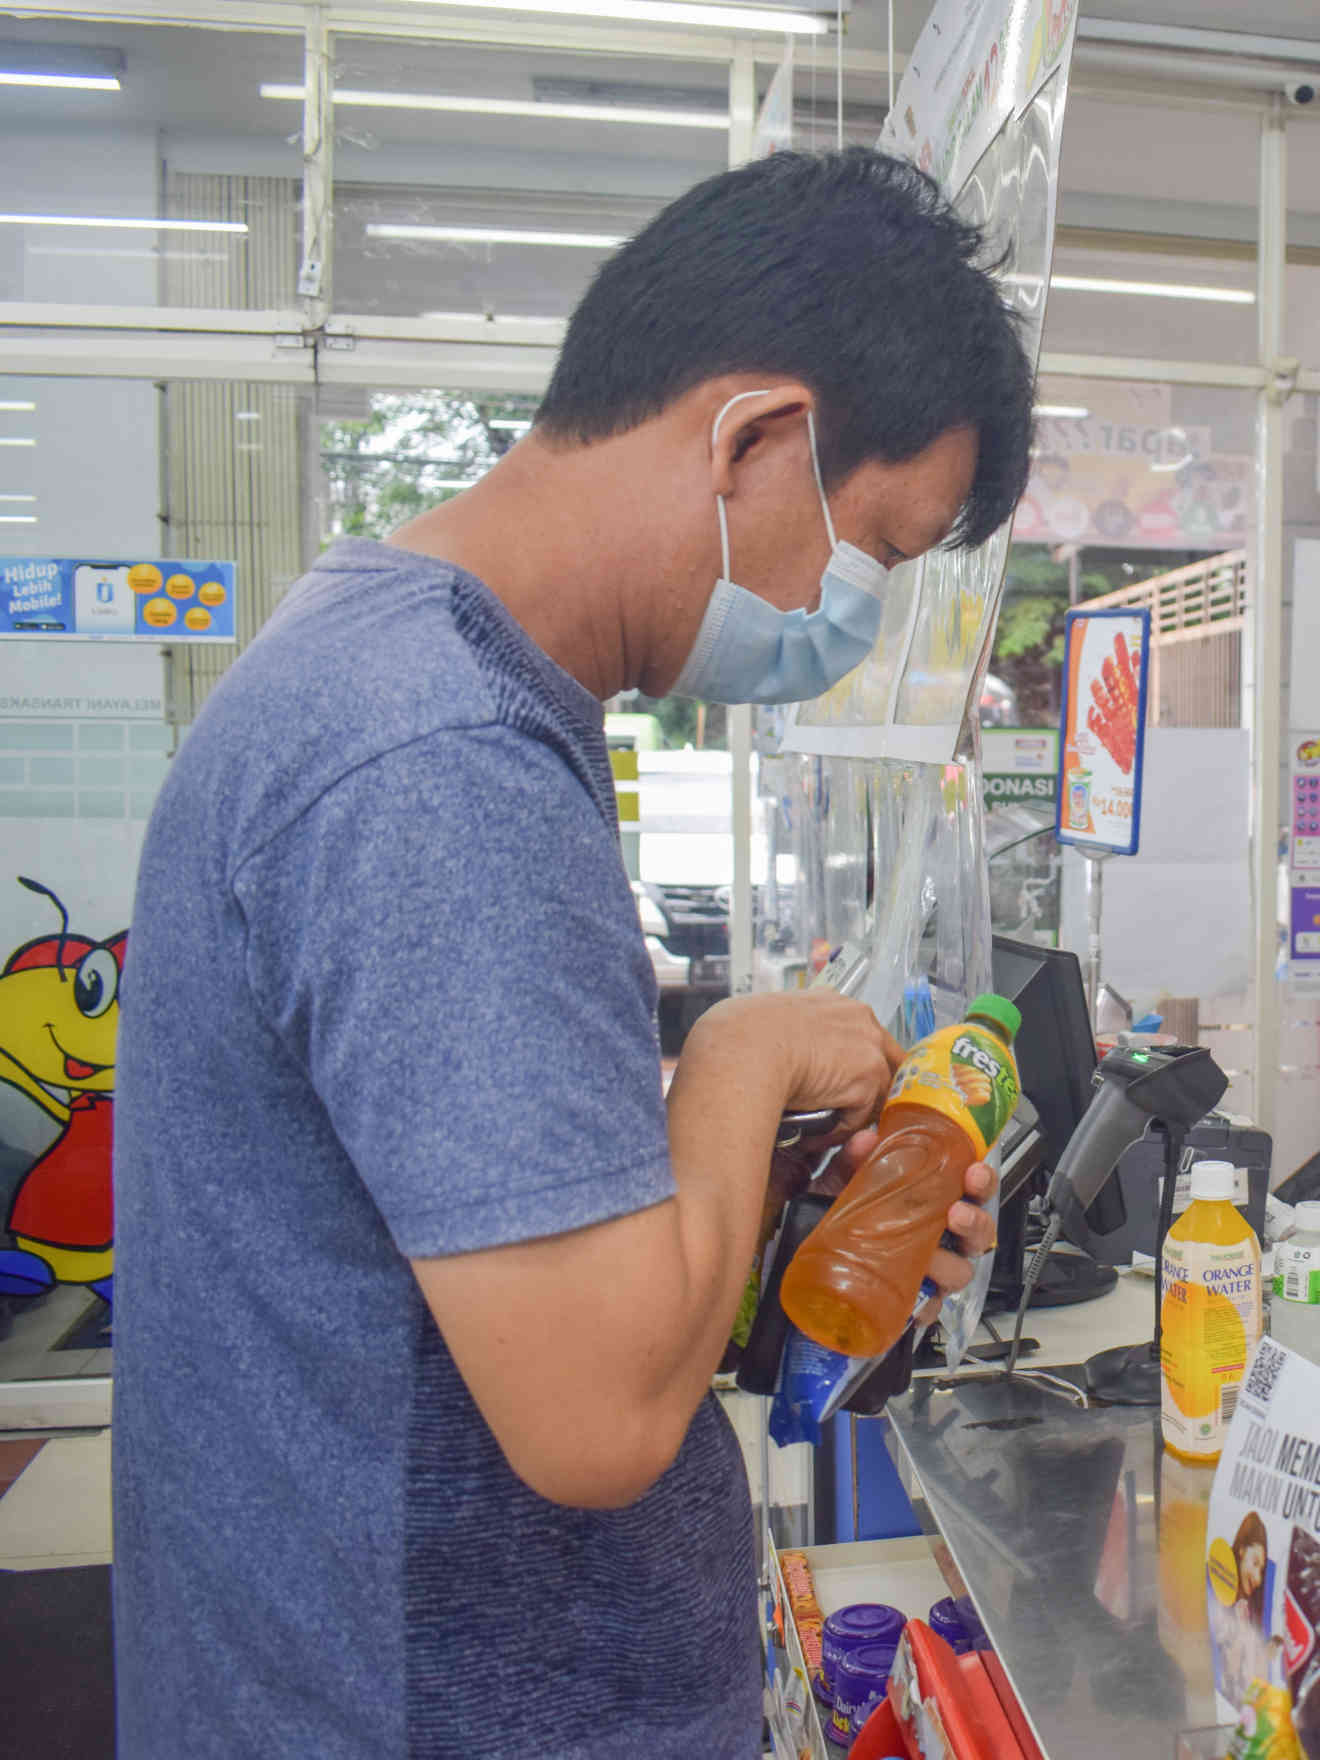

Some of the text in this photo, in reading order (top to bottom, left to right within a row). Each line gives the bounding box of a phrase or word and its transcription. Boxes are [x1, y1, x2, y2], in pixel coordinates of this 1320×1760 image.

[1202, 1264, 1255, 1283] ORANGE
[1206, 1280, 1252, 1298] WATER
[1228, 1461, 1284, 1516] MAKIN
